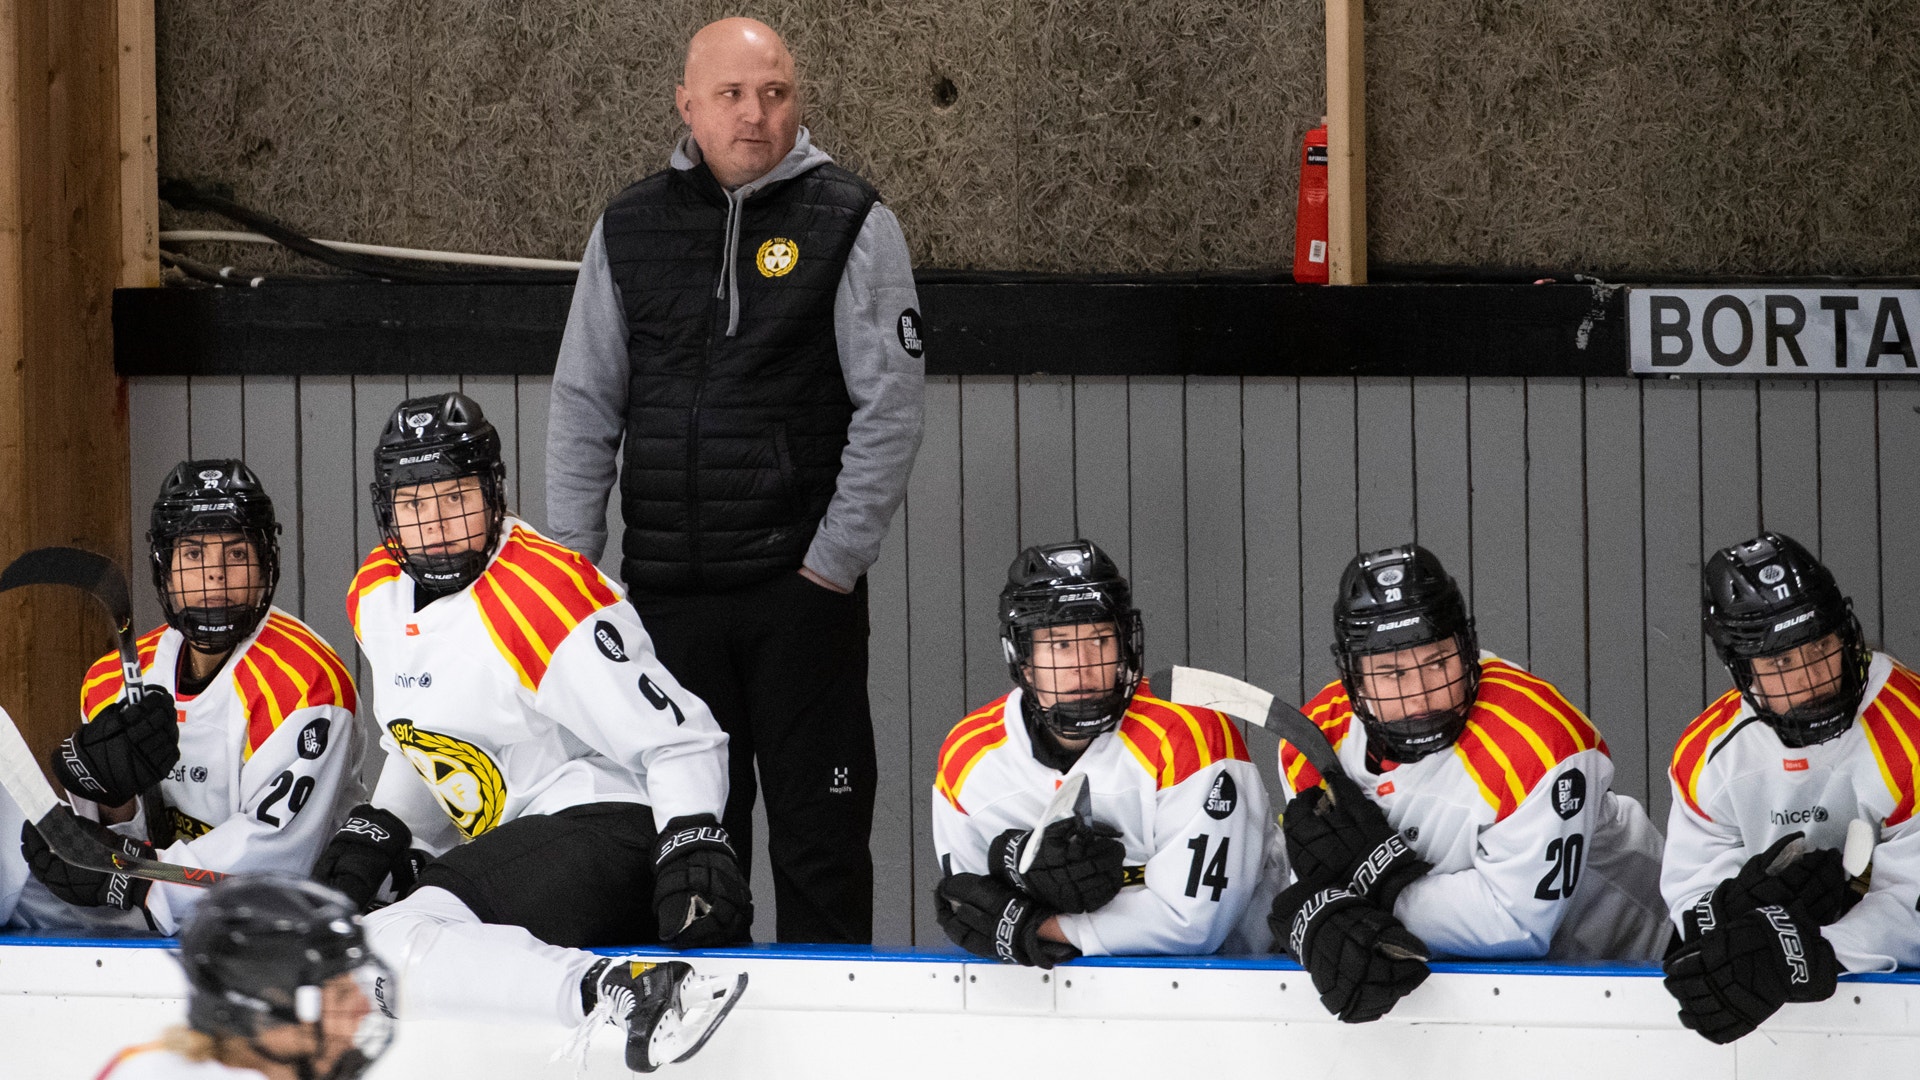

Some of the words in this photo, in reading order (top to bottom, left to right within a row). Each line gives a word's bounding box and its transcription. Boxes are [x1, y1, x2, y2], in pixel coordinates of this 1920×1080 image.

[901, 316, 912, 327] EN
[904, 327, 917, 339] BRA
[1650, 294, 1918, 368] BORTA
[415, 427, 424, 438] 9
[399, 452, 440, 465] BAUER
[204, 480, 219, 489] 29
[1066, 564, 1082, 576] 14
[1384, 587, 1402, 603] 20
[1376, 616, 1420, 632] BAUER
[1774, 610, 1815, 632] BAUER
[638, 672, 685, 727] 9
[303, 727, 317, 740] EN
[1558, 779, 1573, 791] EN
[1184, 833, 1230, 902] 14
[1534, 833, 1584, 901] 20
